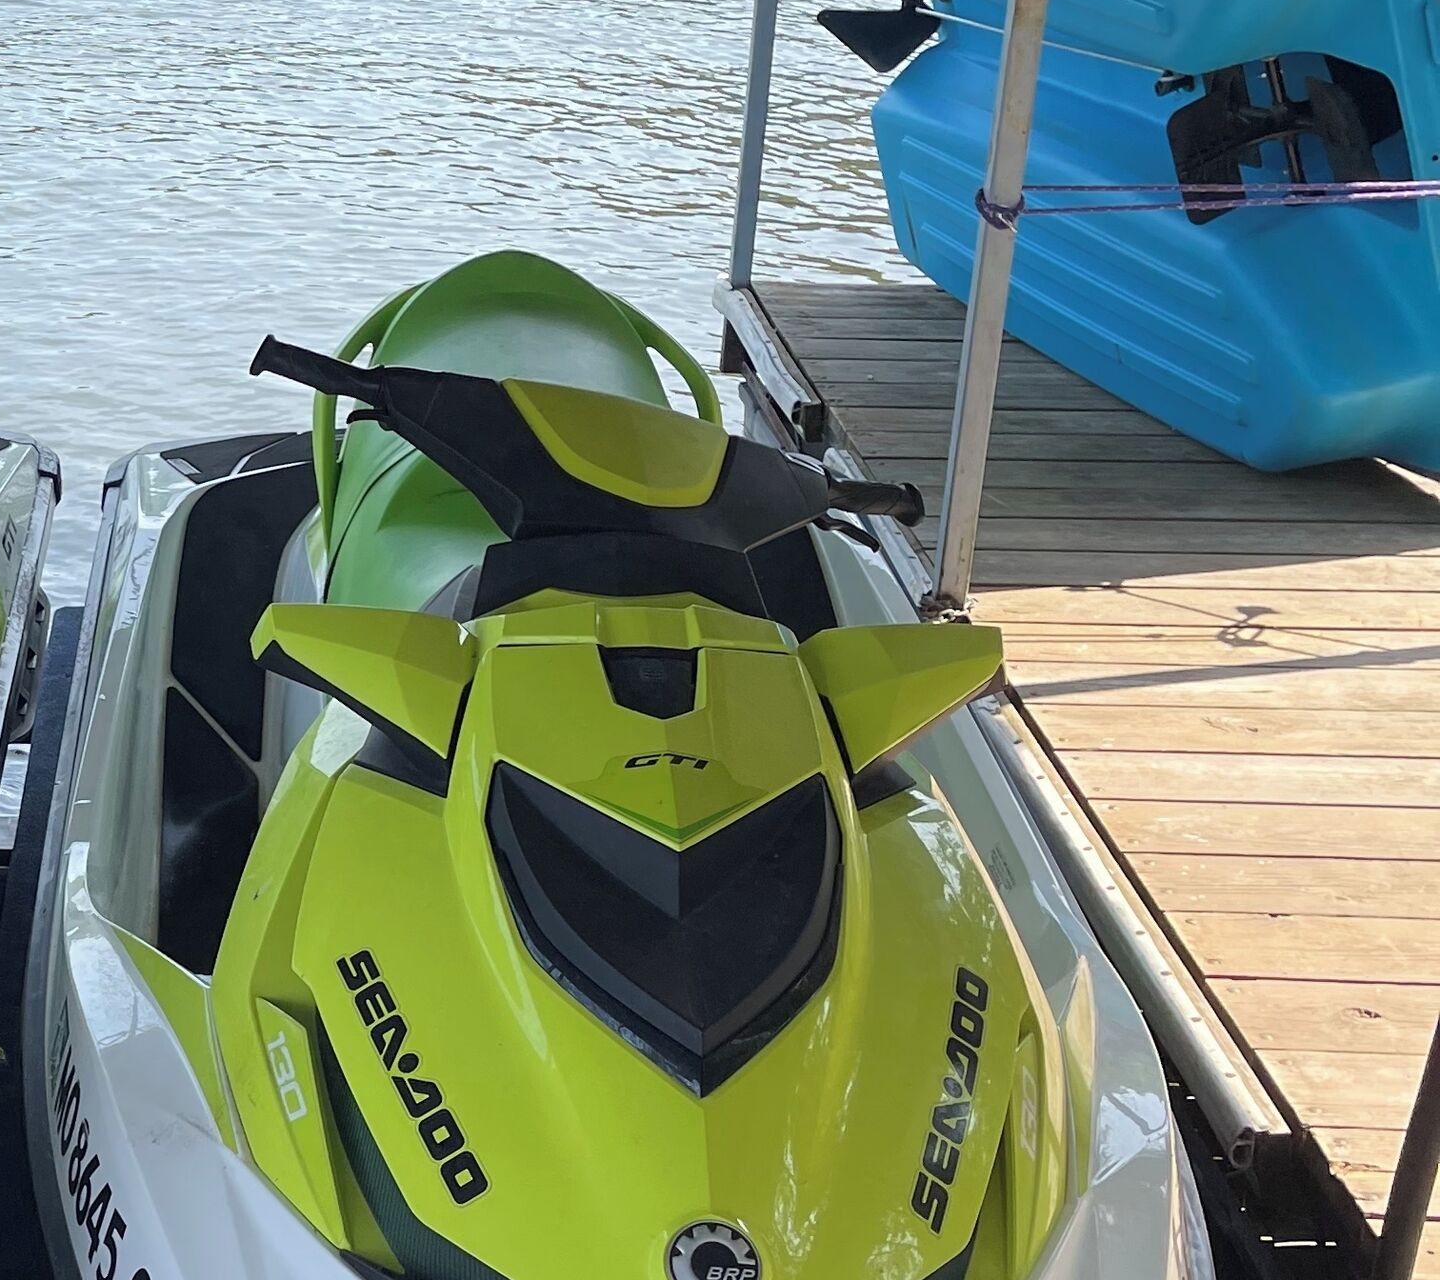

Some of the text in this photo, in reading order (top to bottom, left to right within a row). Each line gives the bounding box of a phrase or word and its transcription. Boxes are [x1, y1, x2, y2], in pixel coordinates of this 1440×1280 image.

[2, 513, 17, 561] GTI
[624, 752, 709, 770] GTI
[267, 1031, 308, 1122] 130
